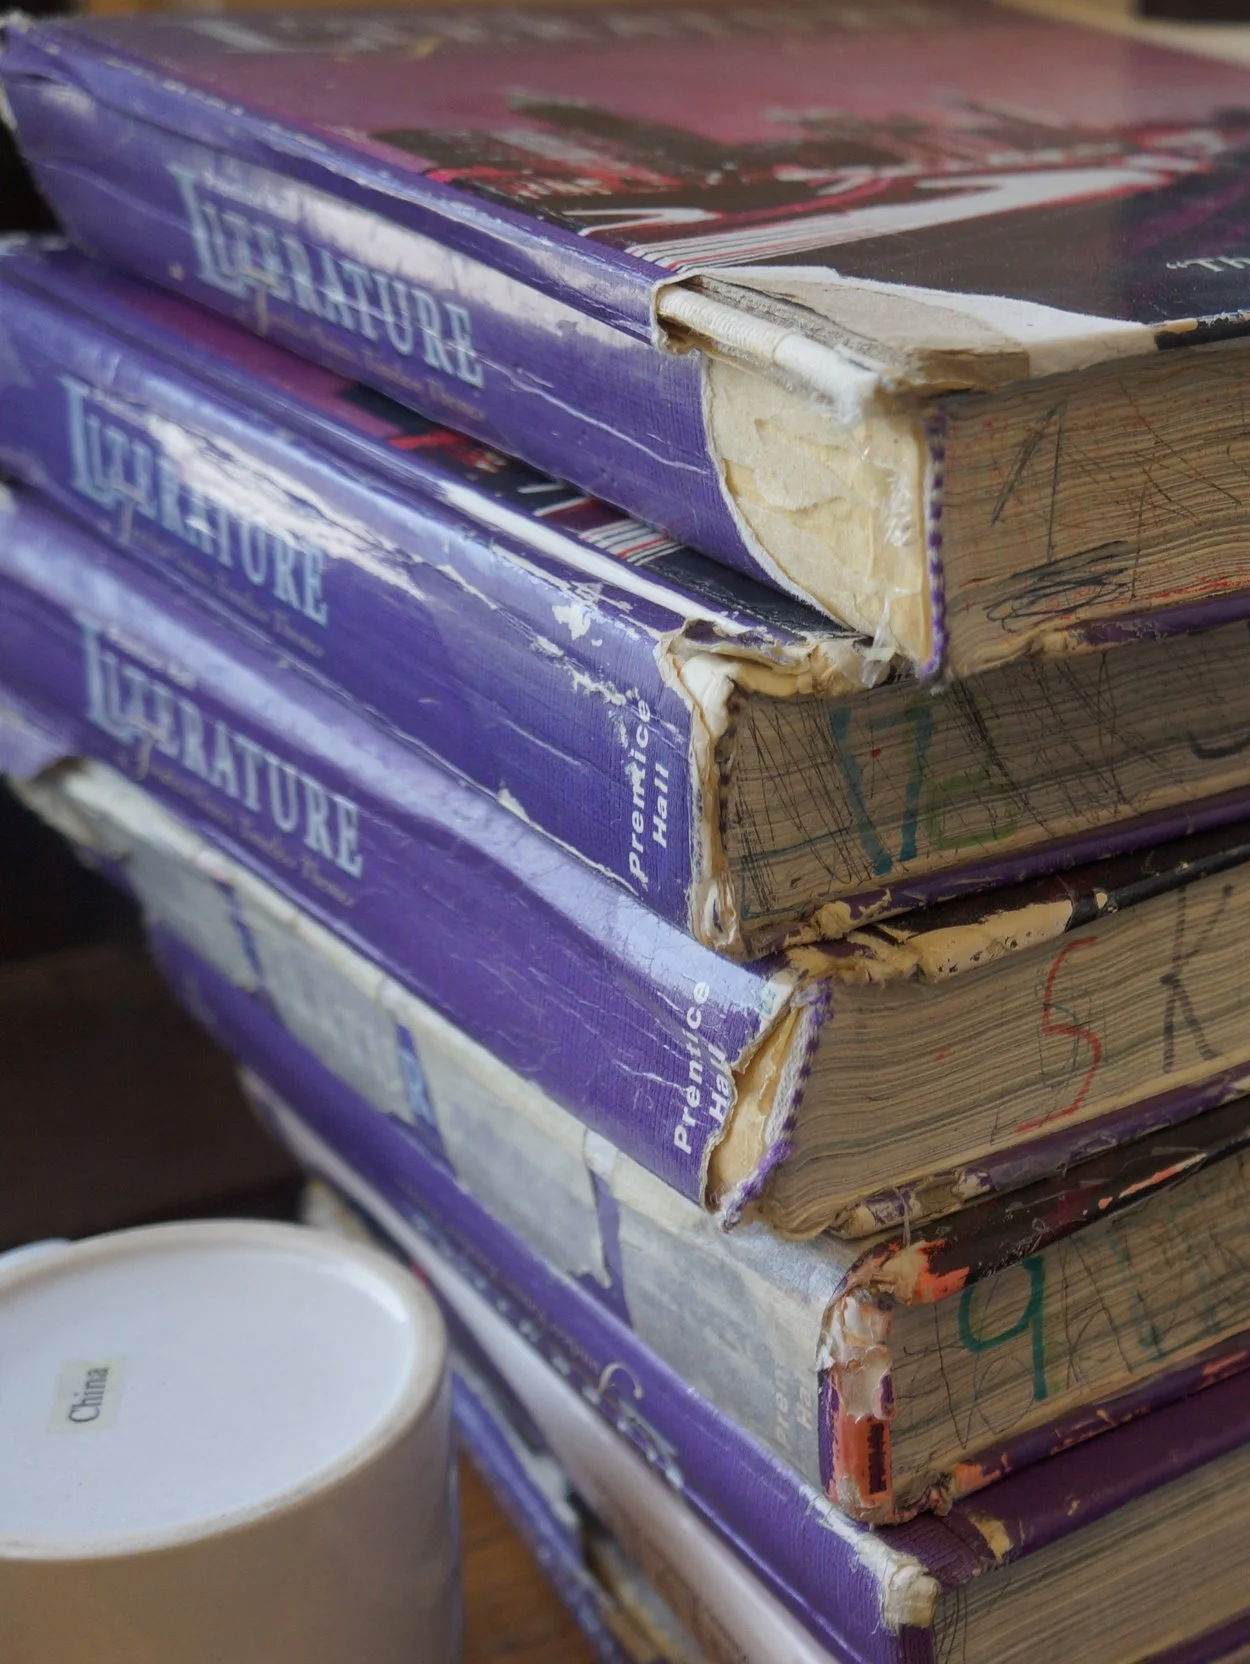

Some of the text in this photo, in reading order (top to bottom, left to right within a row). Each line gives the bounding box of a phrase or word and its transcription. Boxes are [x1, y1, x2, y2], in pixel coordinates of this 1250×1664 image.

[167, 163, 485, 389] LITERATURE
[57, 373, 328, 628] LITERATURE
[77, 611, 363, 878] LITERATURE
[652, 763, 670, 849] Hall
[674, 981, 710, 1155] Prentice
[708, 1043, 729, 1124] Hall
[68, 1366, 109, 1423] China
